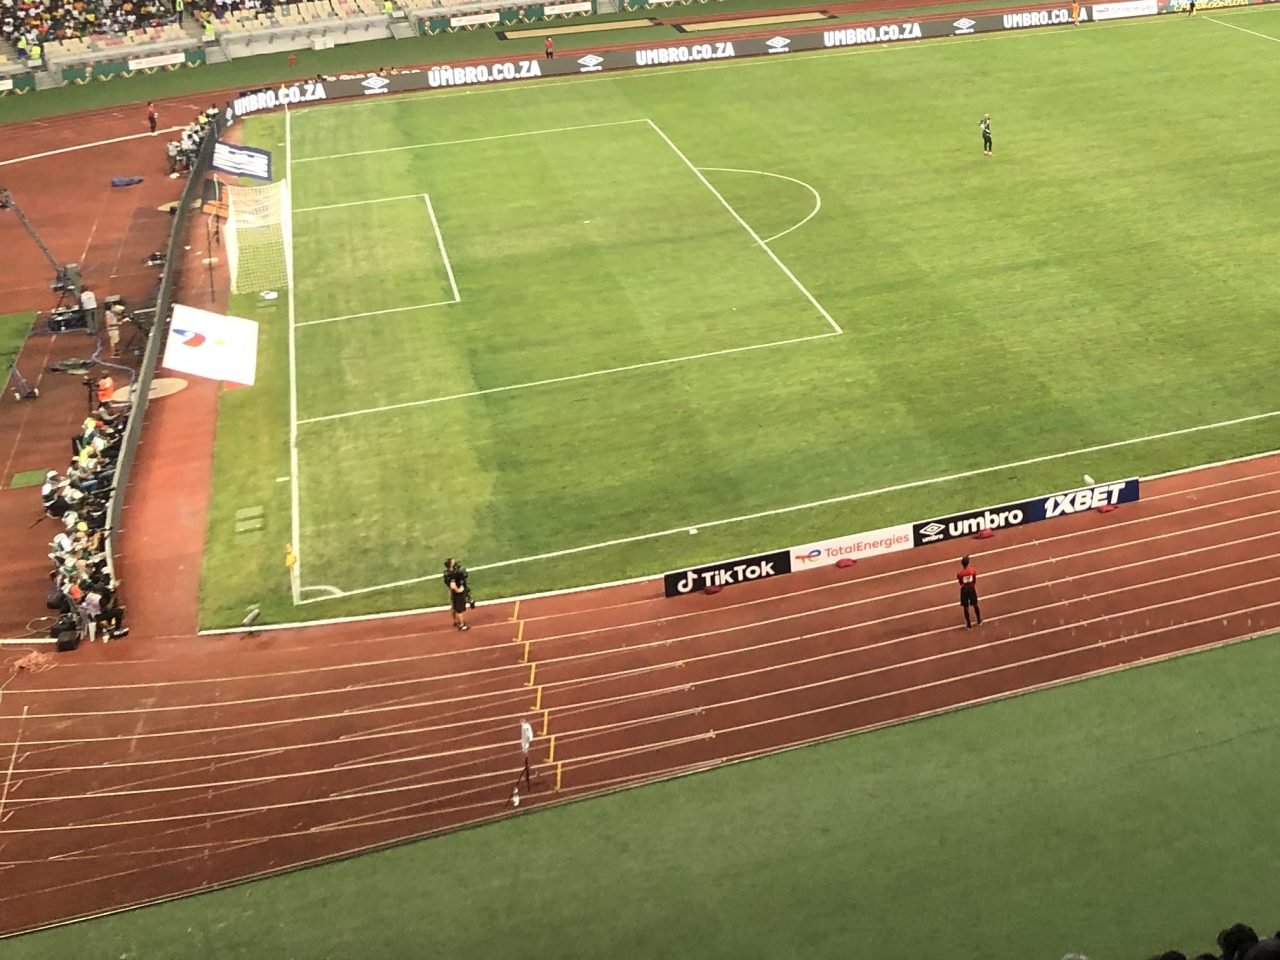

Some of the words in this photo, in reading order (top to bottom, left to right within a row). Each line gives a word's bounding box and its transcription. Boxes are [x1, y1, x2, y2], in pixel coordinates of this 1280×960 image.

[1003, 7, 1088, 29] UMBRO.CO.A
[823, 23, 922, 47] UMBRO.CO.ZA
[636, 42, 735, 66] UMBRO.CO.ZA
[428, 60, 542, 87] UMBRO.CO.ZA
[234, 83, 326, 116] UMBRO.CO.ZA
[1044, 483, 1126, 519] 1XBET
[949, 507, 1024, 537] umbro
[825, 533, 910, 558] TotalEnergies
[922, 533, 944, 543] umbro
[701, 560, 776, 588] TikTok
